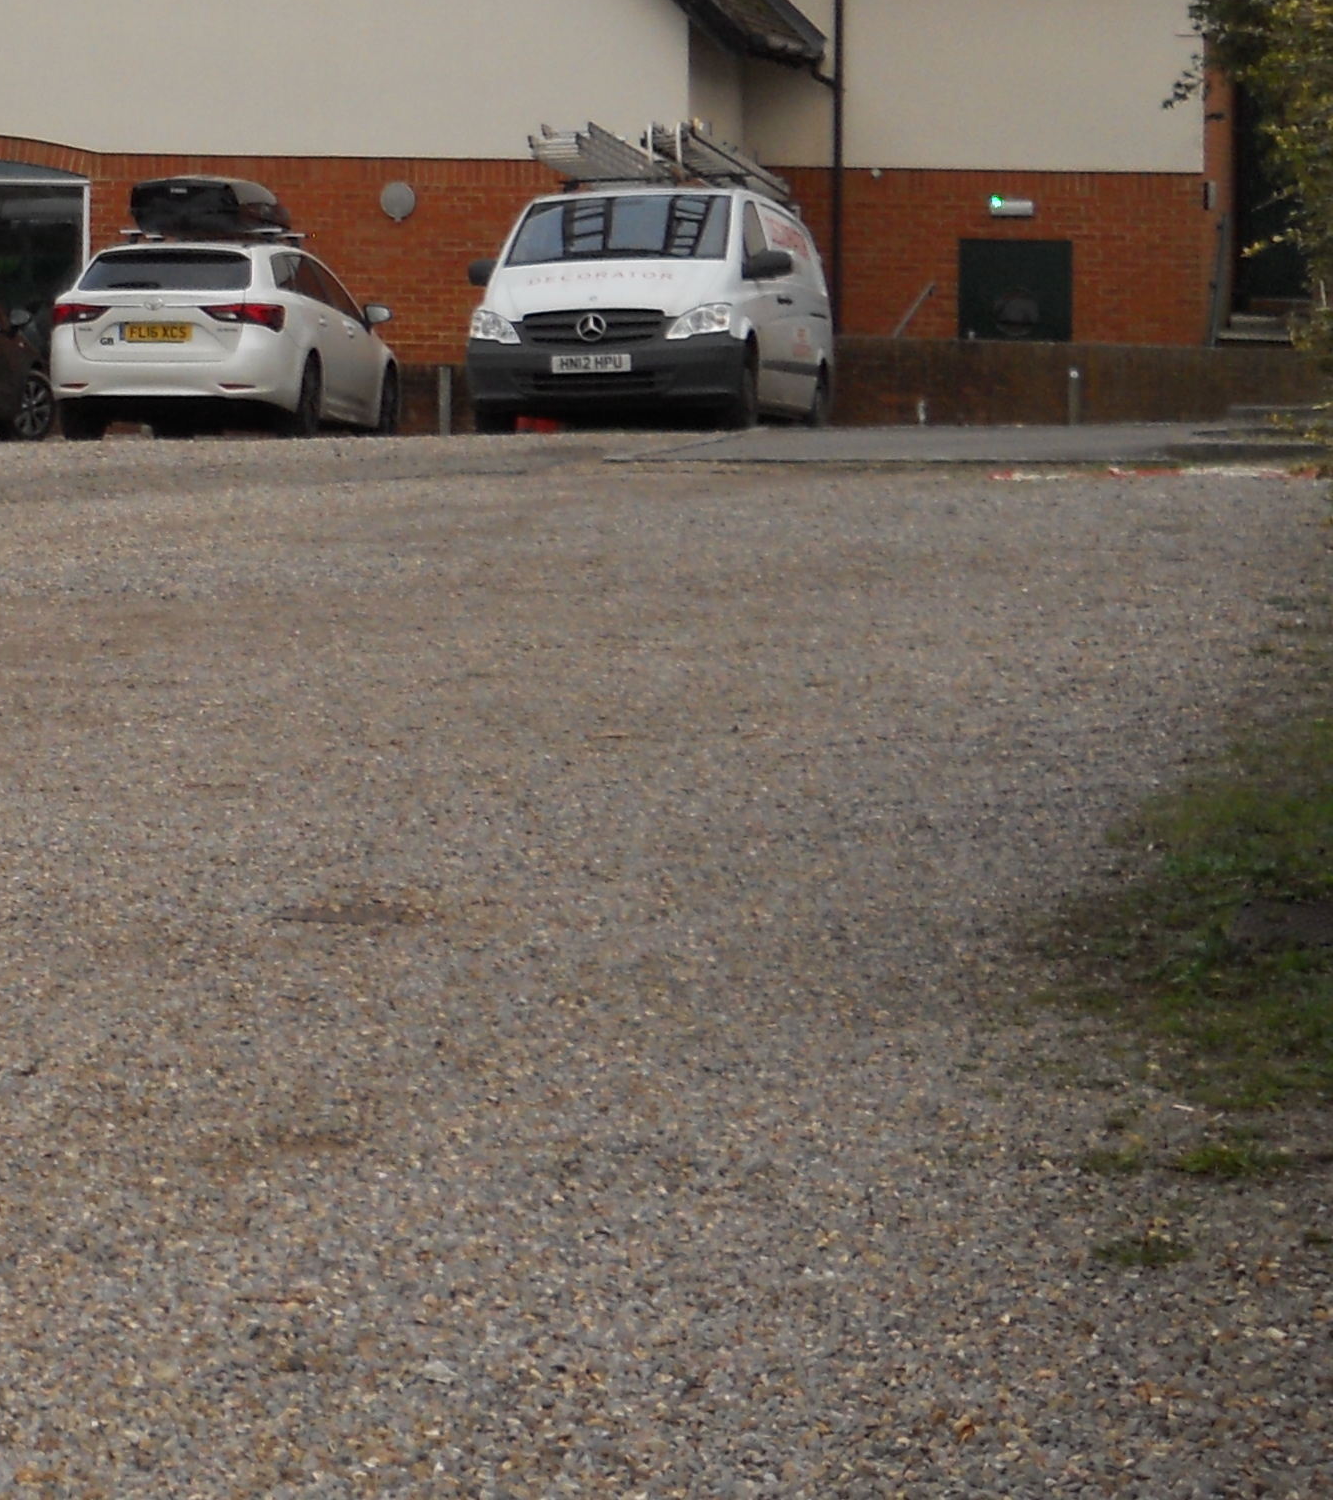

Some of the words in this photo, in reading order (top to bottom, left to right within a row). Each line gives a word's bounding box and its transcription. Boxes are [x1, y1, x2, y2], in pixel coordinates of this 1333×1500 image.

[529, 271, 673, 286] DECORATOR
[162, 323, 187, 339] XCS
[100, 337, 114, 346] GB
[560, 356, 591, 371] HN12
[595, 355, 623, 370] HPU
